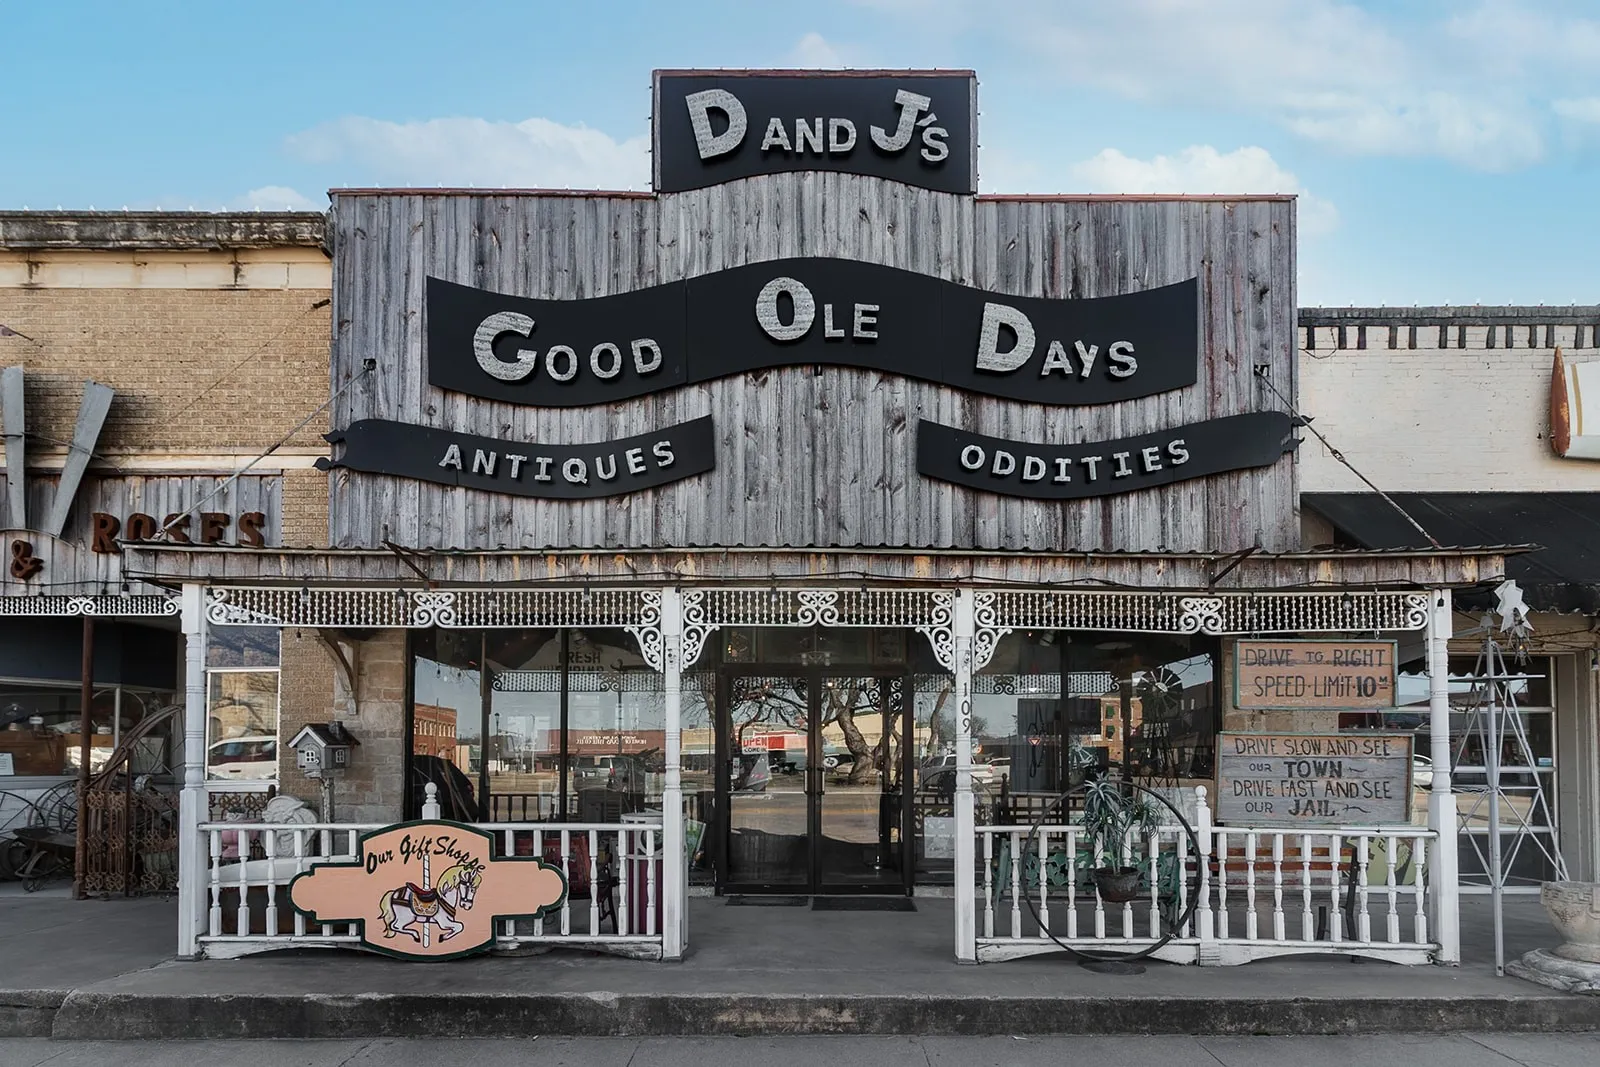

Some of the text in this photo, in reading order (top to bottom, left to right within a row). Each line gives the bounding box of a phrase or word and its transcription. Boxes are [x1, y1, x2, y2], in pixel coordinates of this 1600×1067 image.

[685, 89, 747, 159] D
[760, 118, 857, 153] AND
[473, 277, 1139, 382] GOOD OLE DAYS
[438, 440, 1190, 485] ANTIQUES ODDITIES
[92, 512, 265, 554] ROSES
[10, 539, 44, 580] &
[1245, 649, 1385, 667] DRIVE TO RIGHT
[1254, 675, 1305, 697] SPEED
[961, 682, 970, 733] 109
[743, 736, 767, 747] OPEN
[1235, 738, 1392, 757] DRIVE SLOW AND SEE
[1249, 760, 1342, 778] OUR TOWN
[1233, 779, 1274, 797] DRIVE
[1324, 780, 1359, 798] AND
[1363, 781, 1393, 799] SEE
[1245, 801, 1273, 813] OUR
[366, 834, 486, 875] Our Gift Shoppe
